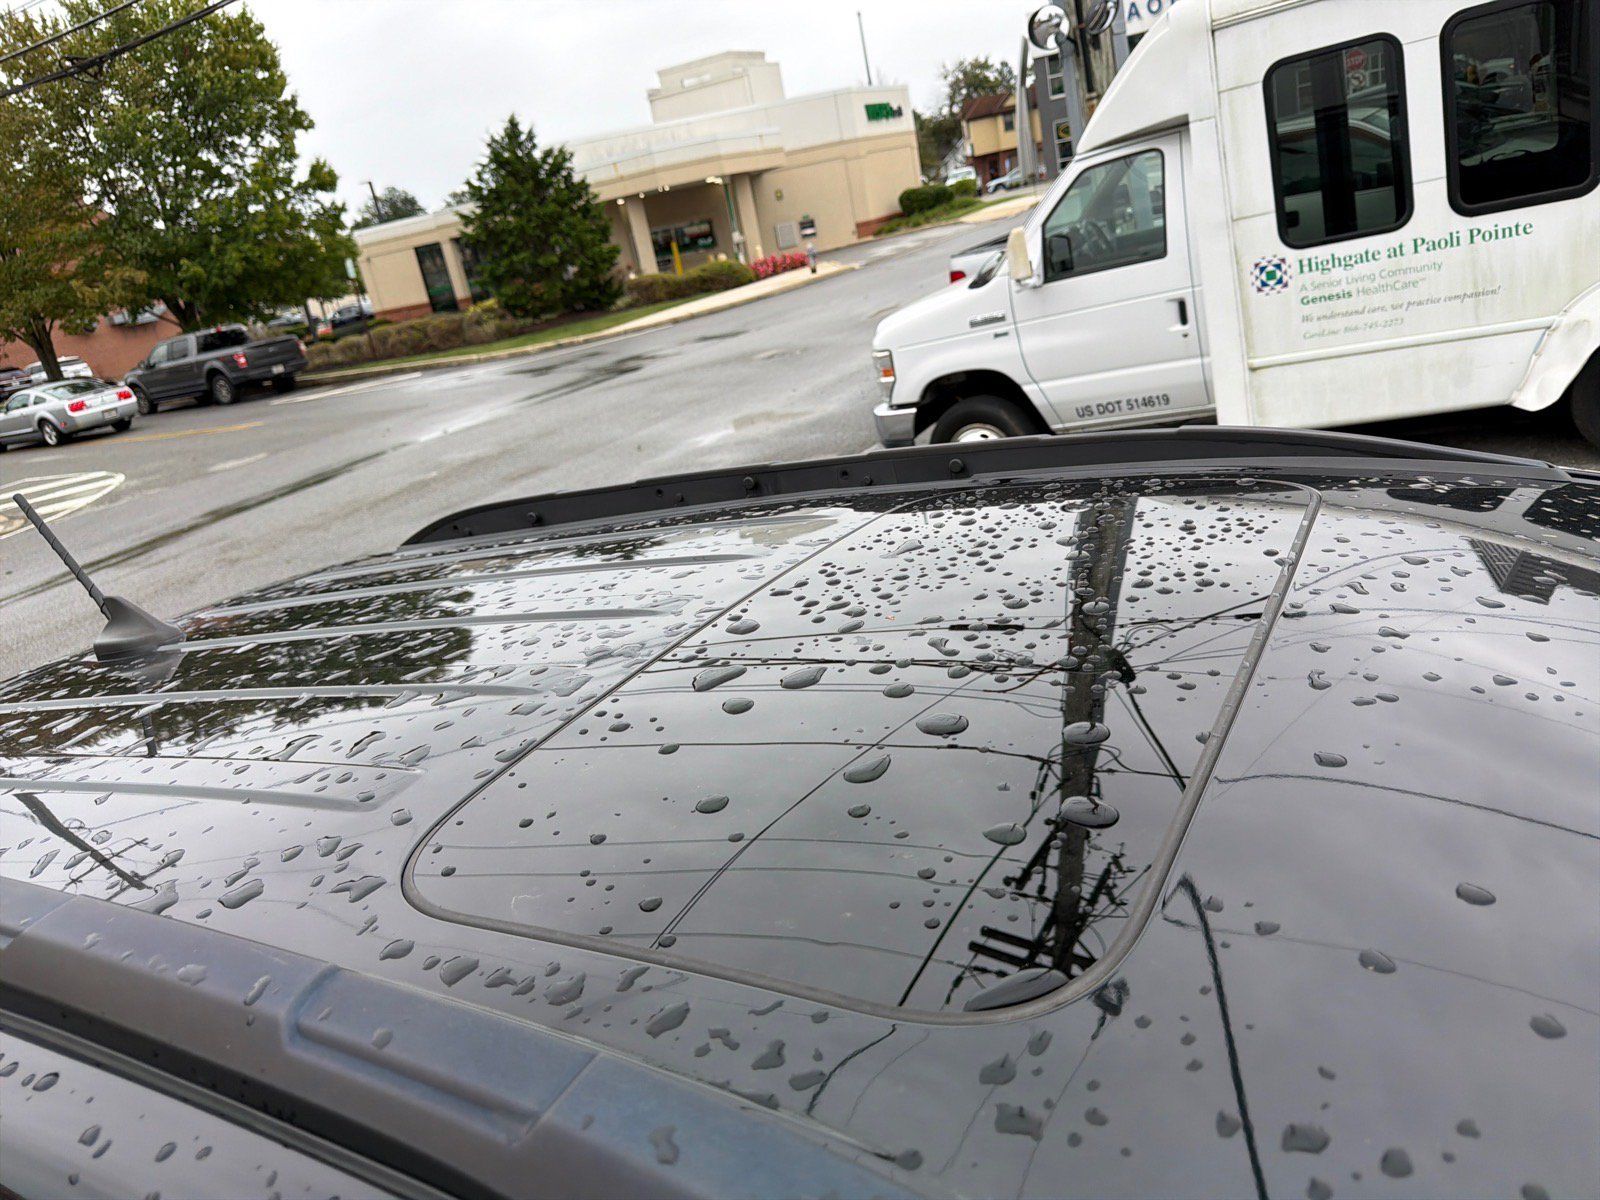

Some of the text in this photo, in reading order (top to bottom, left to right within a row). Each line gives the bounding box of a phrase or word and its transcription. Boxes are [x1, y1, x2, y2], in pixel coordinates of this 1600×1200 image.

[1298, 222, 1534, 275] Highgate at Paoli Pointe
[1300, 261, 1443, 292] A Senior Living Community
[1300, 289, 1353, 306] Genesis
[1302, 313, 1314, 323] We
[1316, 305, 1366, 322] understand
[1405, 295, 1441, 311] practice
[1443, 284, 1501, 304] compassion!
[1075, 393, 1170, 418] US DOT 514619
